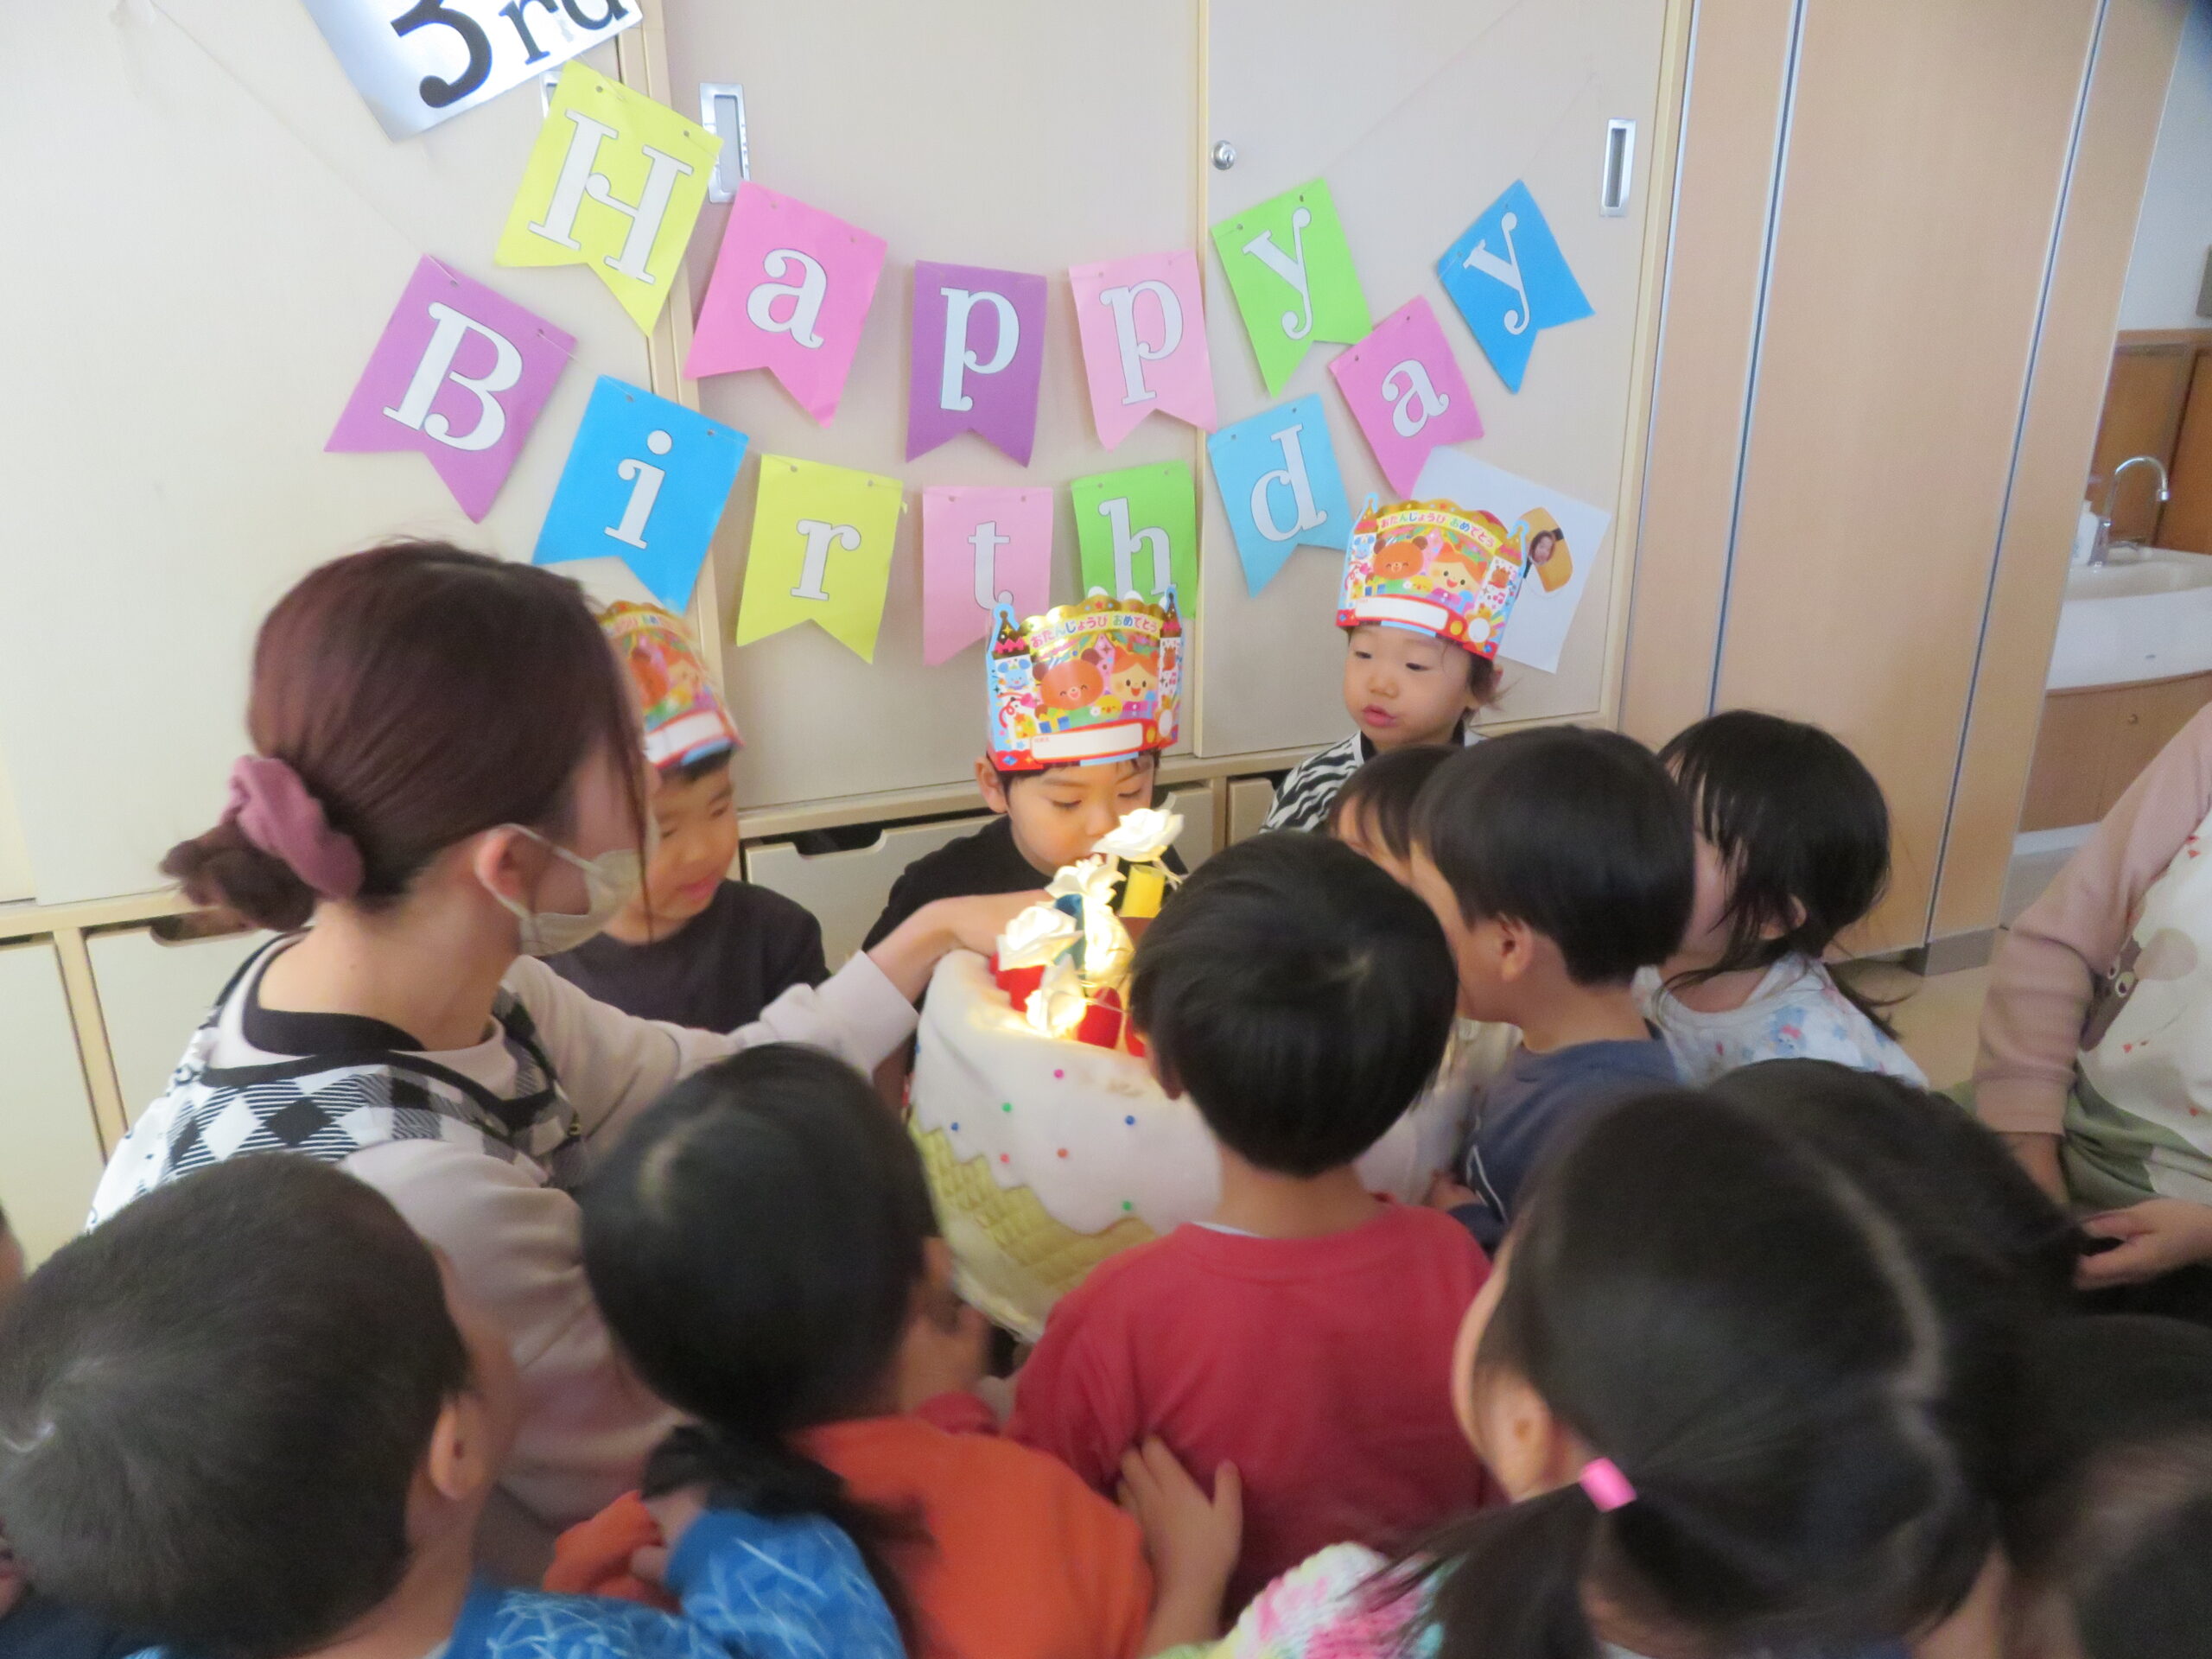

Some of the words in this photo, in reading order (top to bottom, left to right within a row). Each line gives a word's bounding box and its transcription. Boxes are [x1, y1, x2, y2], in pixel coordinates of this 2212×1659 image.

[527, 108, 1313, 412] Happy
[382, 212, 1531, 610] Birthday
[1381, 512, 1447, 529] おたんじょうび
[1449, 518, 1496, 548] おめでとう
[1030, 614, 1109, 648] おたんじょうび
[1113, 614, 1158, 632] おめでとう
